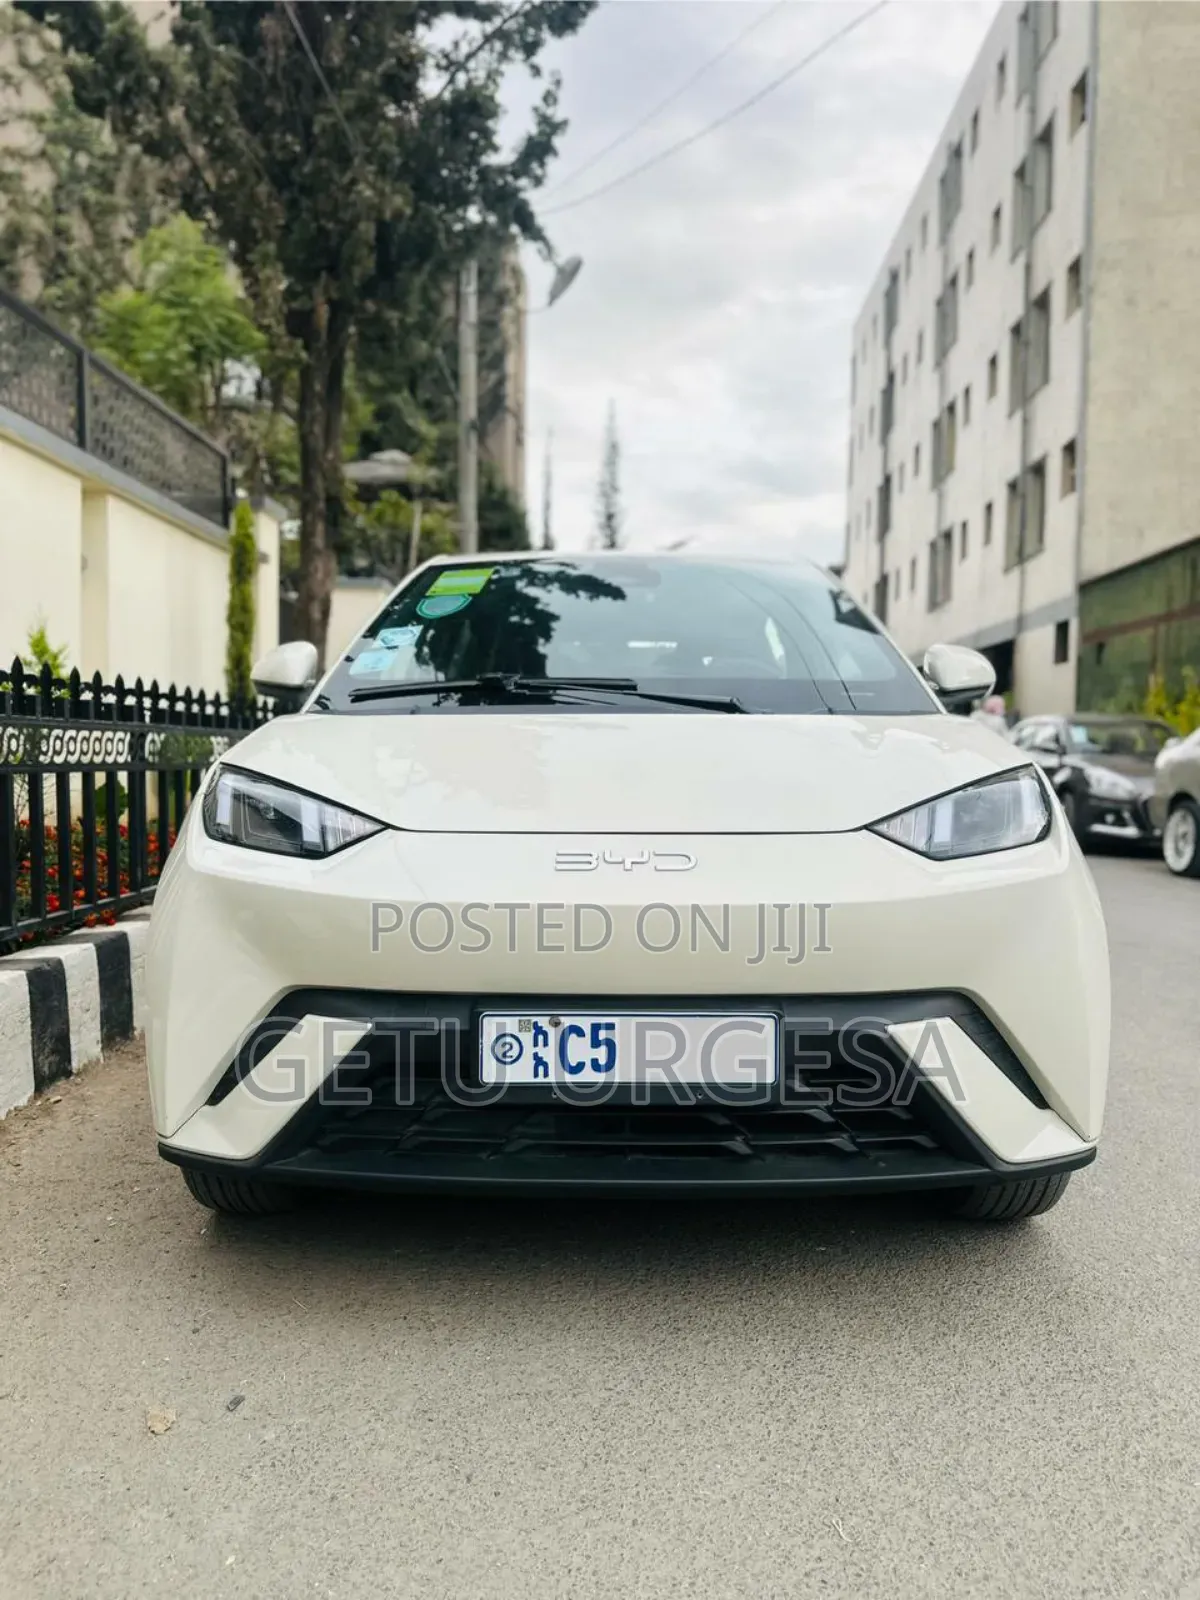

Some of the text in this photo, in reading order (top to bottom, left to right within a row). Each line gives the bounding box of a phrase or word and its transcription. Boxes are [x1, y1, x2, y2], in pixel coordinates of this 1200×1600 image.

[555, 849, 698, 871] BYD
[500, 1041, 514, 1059] 2
[560, 1023, 616, 1075] C5
